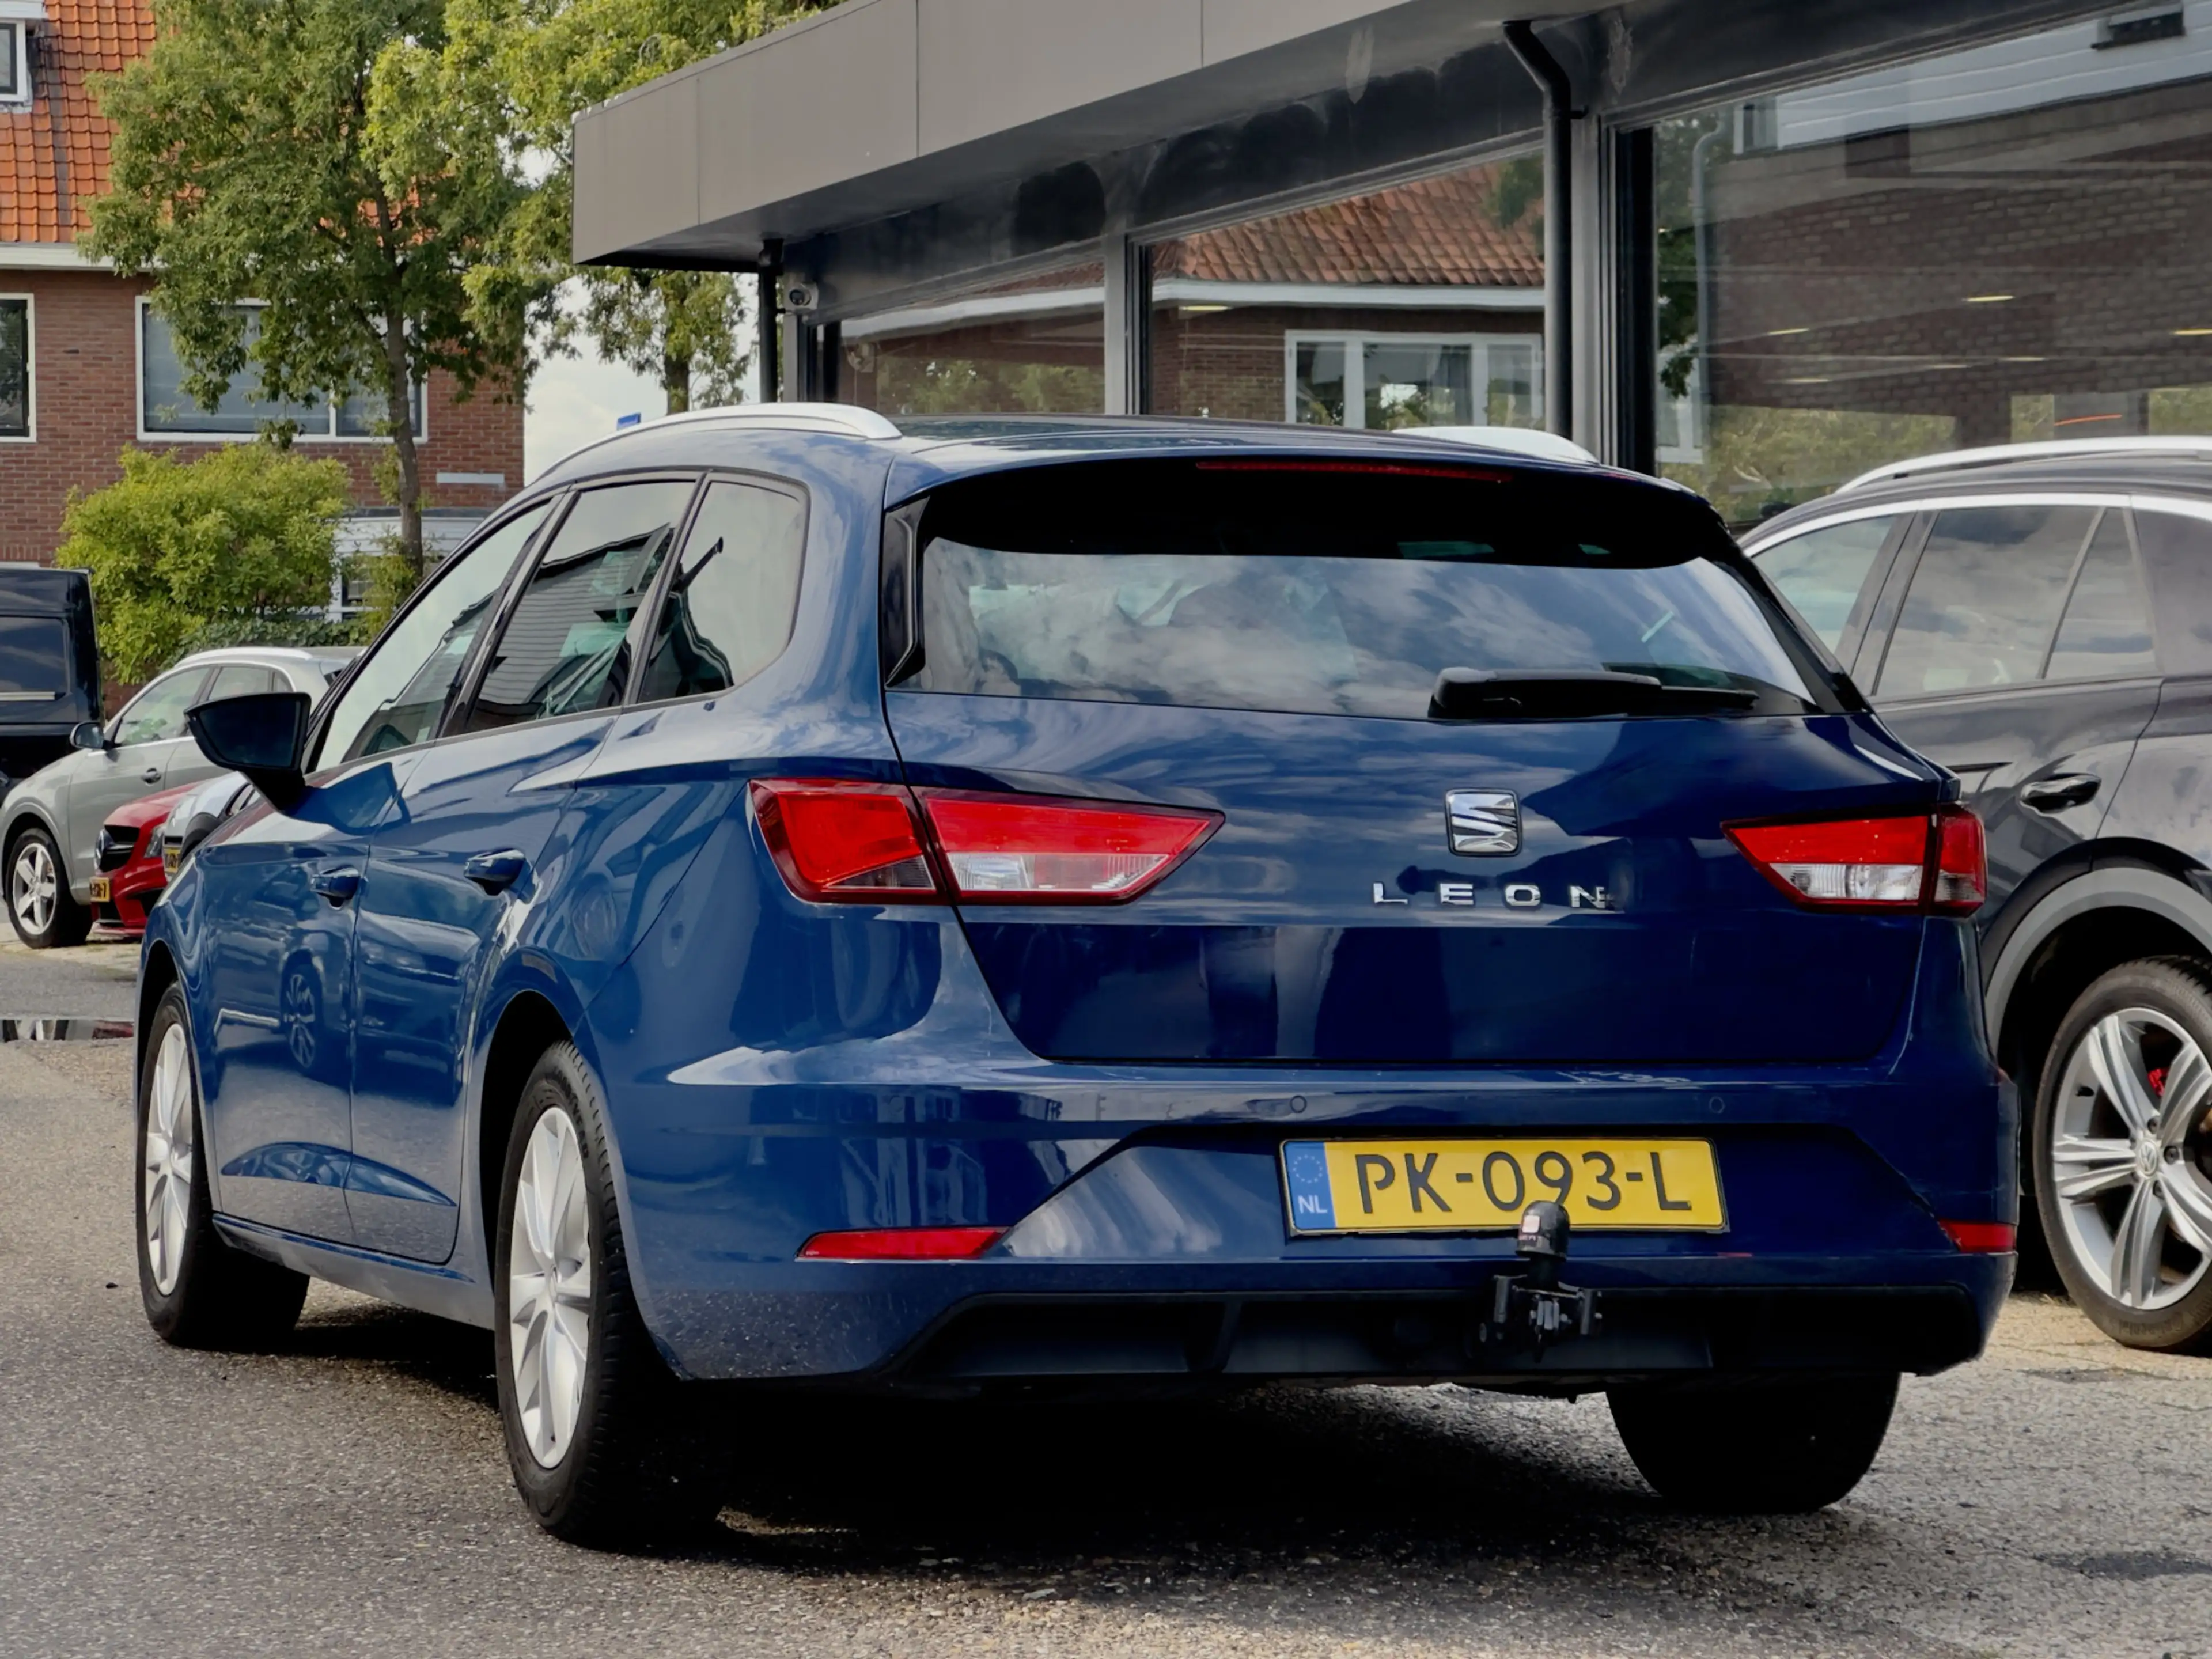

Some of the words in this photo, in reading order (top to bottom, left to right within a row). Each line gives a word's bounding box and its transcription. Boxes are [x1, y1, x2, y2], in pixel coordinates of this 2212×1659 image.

[1373, 882, 1605, 908] LEON
[1354, 1150, 1692, 1214] PK-093-L
[1298, 1195, 1328, 1214] NL
